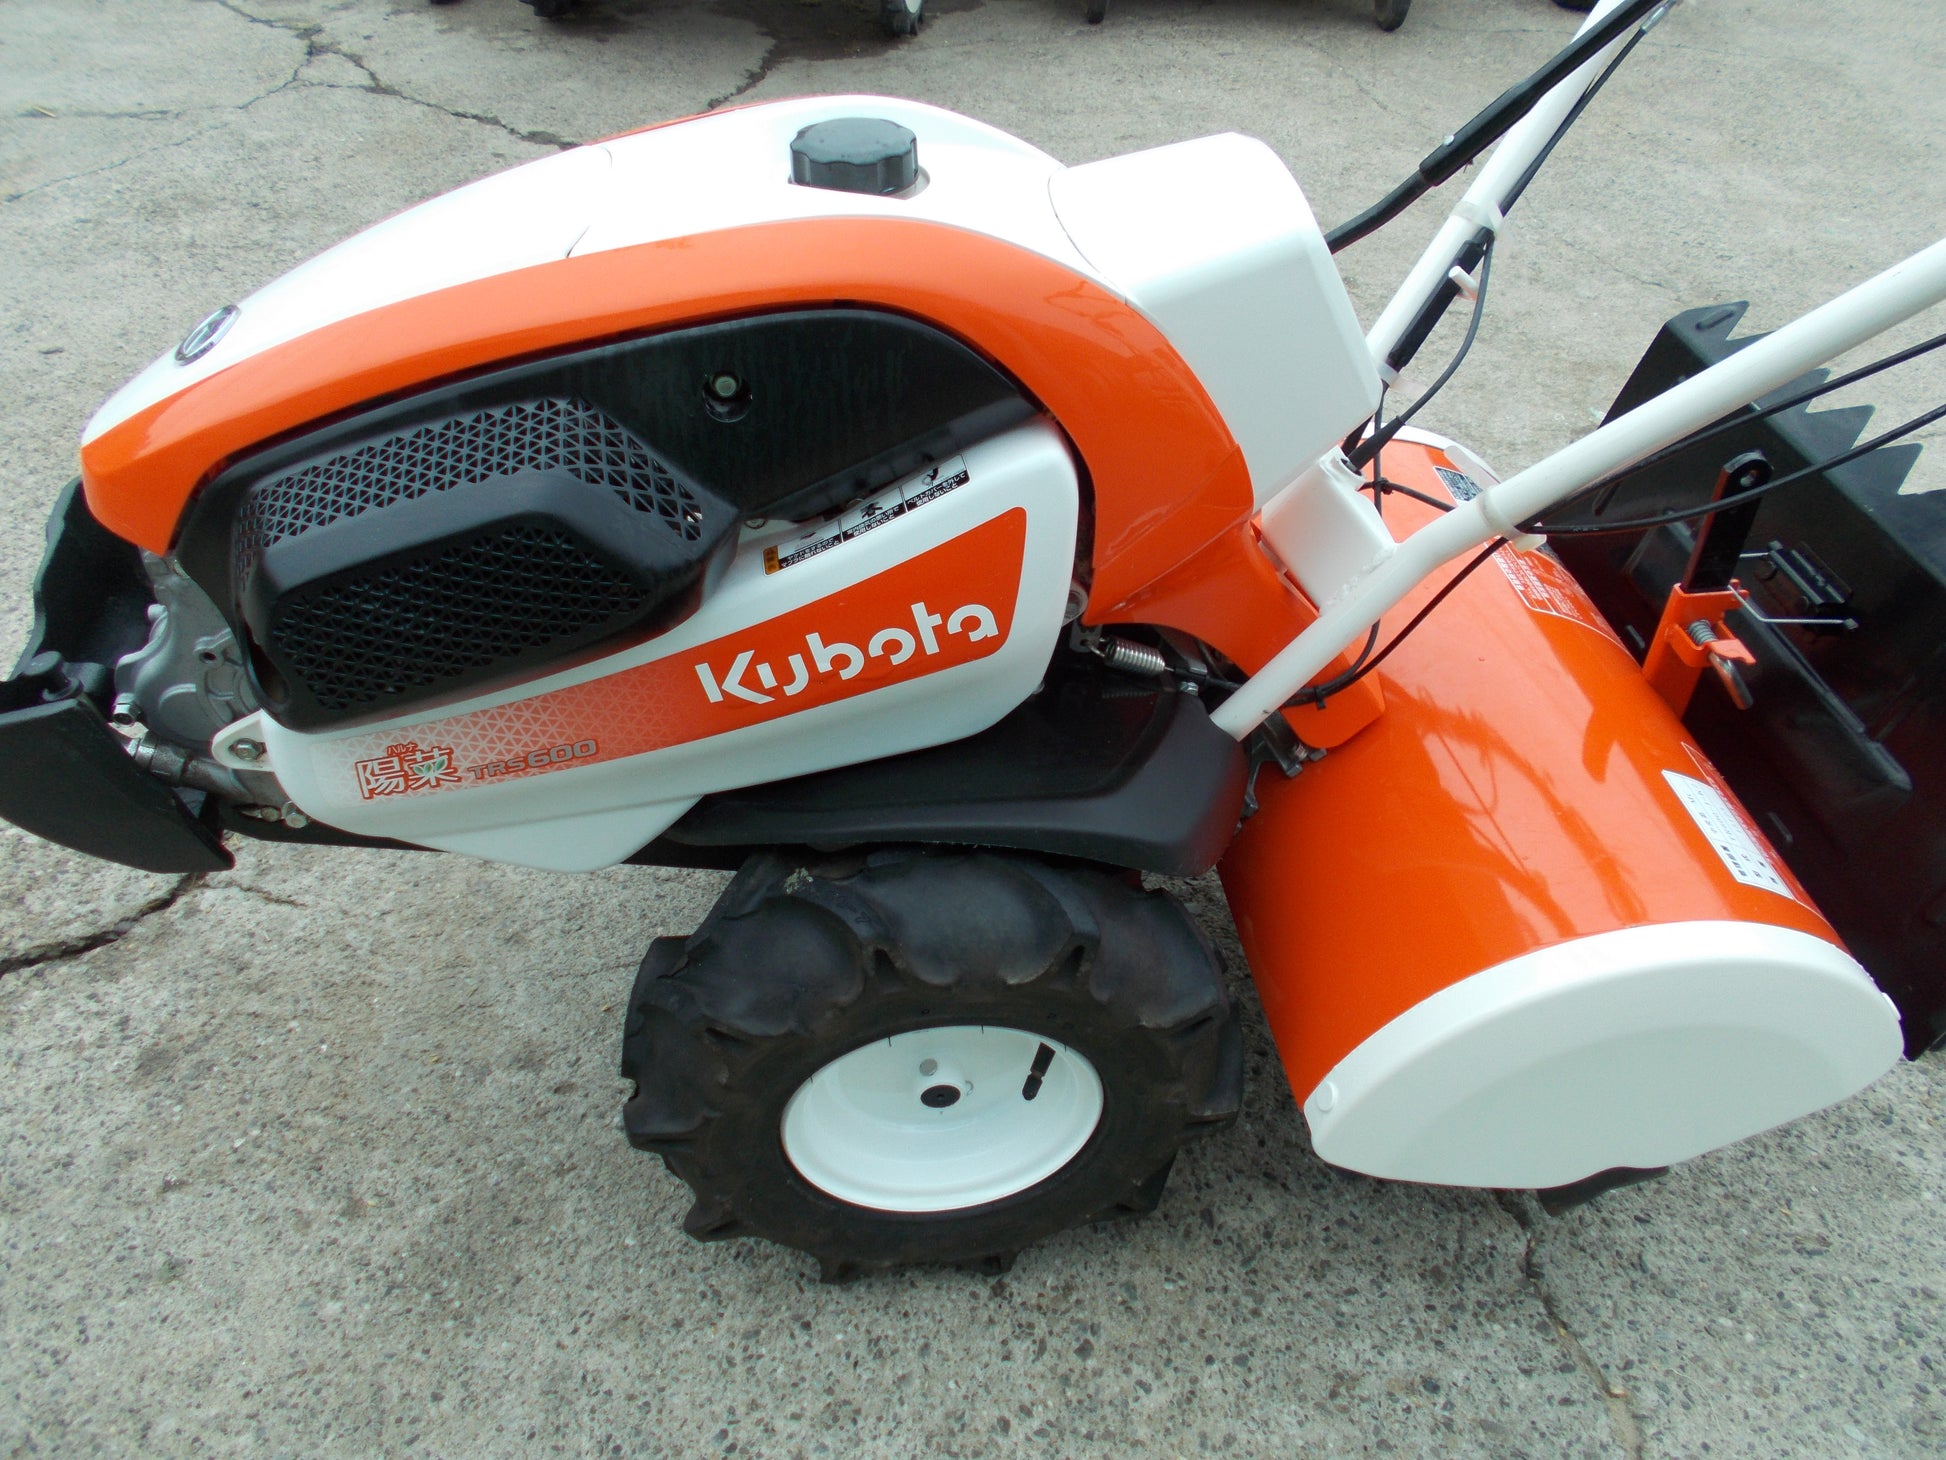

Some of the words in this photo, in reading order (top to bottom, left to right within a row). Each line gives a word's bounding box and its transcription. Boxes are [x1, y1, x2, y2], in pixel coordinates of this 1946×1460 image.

[694, 601, 999, 705] Kubota
[356, 747, 461, 799] 陽菜
[388, 742, 417, 755] ハルナ
